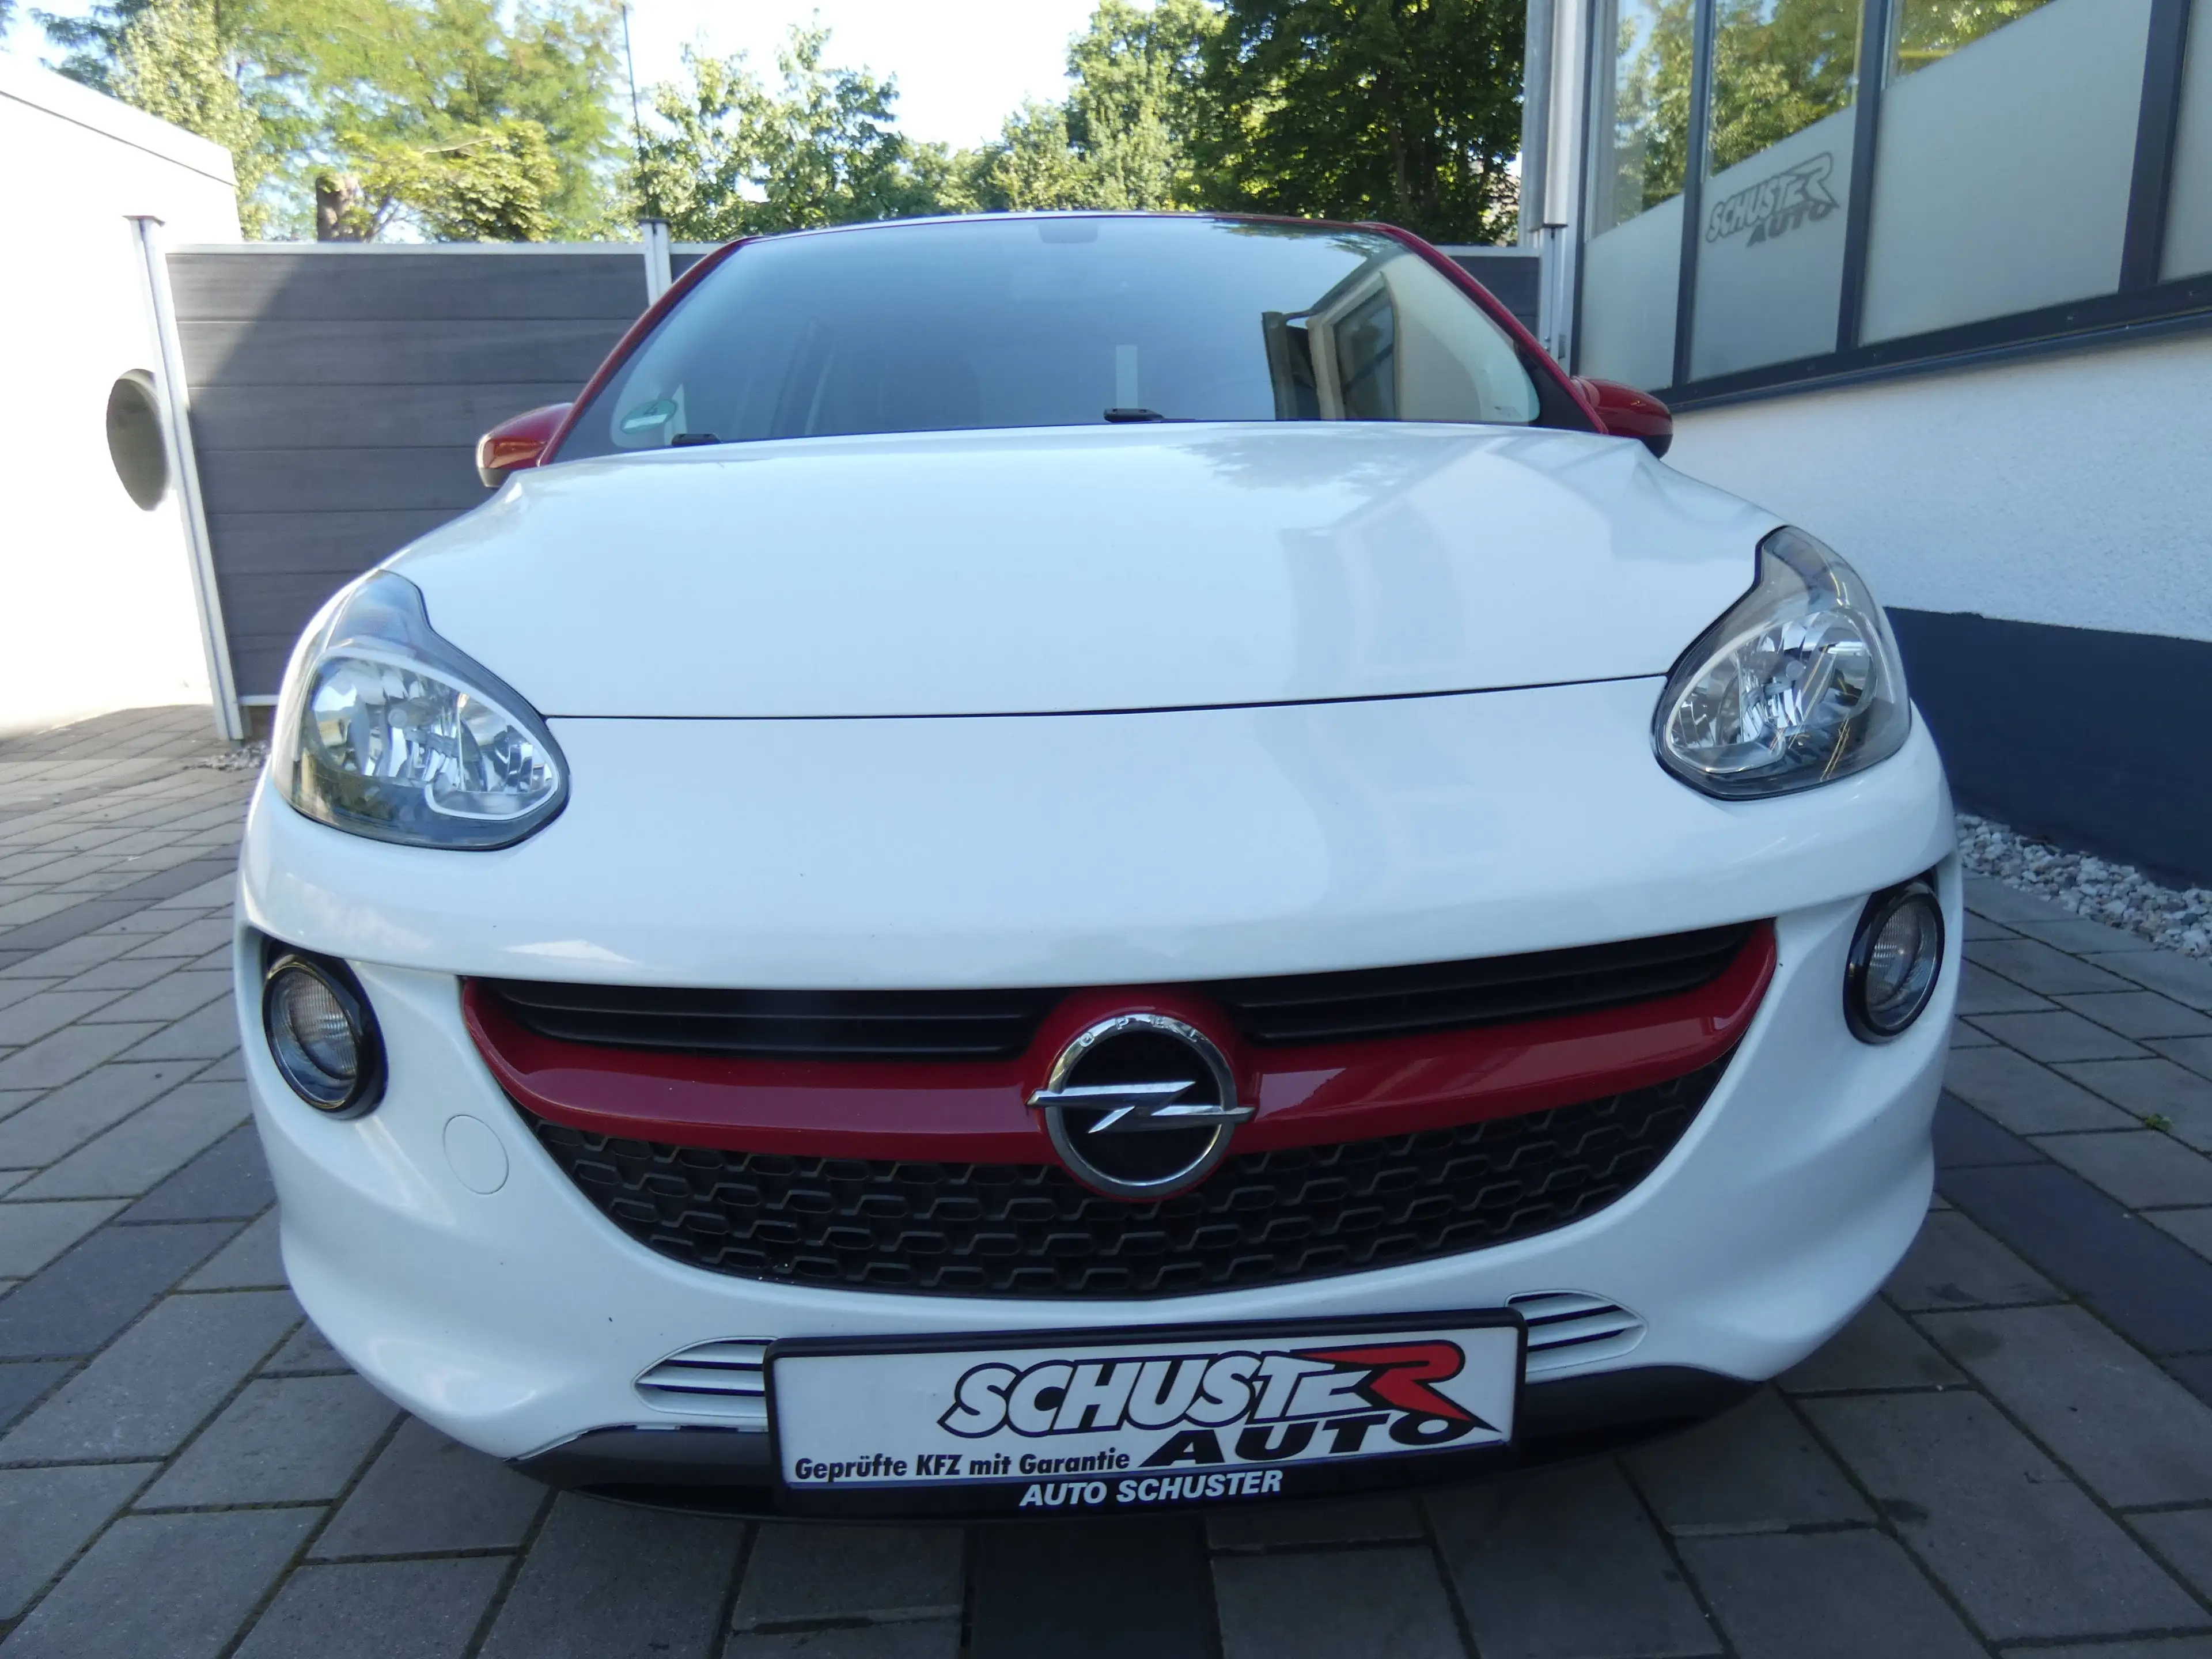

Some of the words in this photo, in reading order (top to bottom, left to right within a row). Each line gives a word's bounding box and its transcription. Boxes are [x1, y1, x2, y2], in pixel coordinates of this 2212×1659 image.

[1706, 151, 1840, 243] SCHUSTER
[1746, 202, 1834, 248] AUTO
[1079, 1016, 1198, 1047] OPEL
[937, 1339, 1502, 1439] SCHUSTER
[1138, 1411, 1476, 1467] AUTO
[795, 1453, 908, 1483] Geprüfte
[916, 1454, 963, 1476] KFZ
[969, 1452, 1012, 1475] mit
[1019, 1446, 1130, 1475] Garantie
[1018, 1481, 1107, 1507] AUTO
[1116, 1469, 1284, 1502] SCHUSTER
